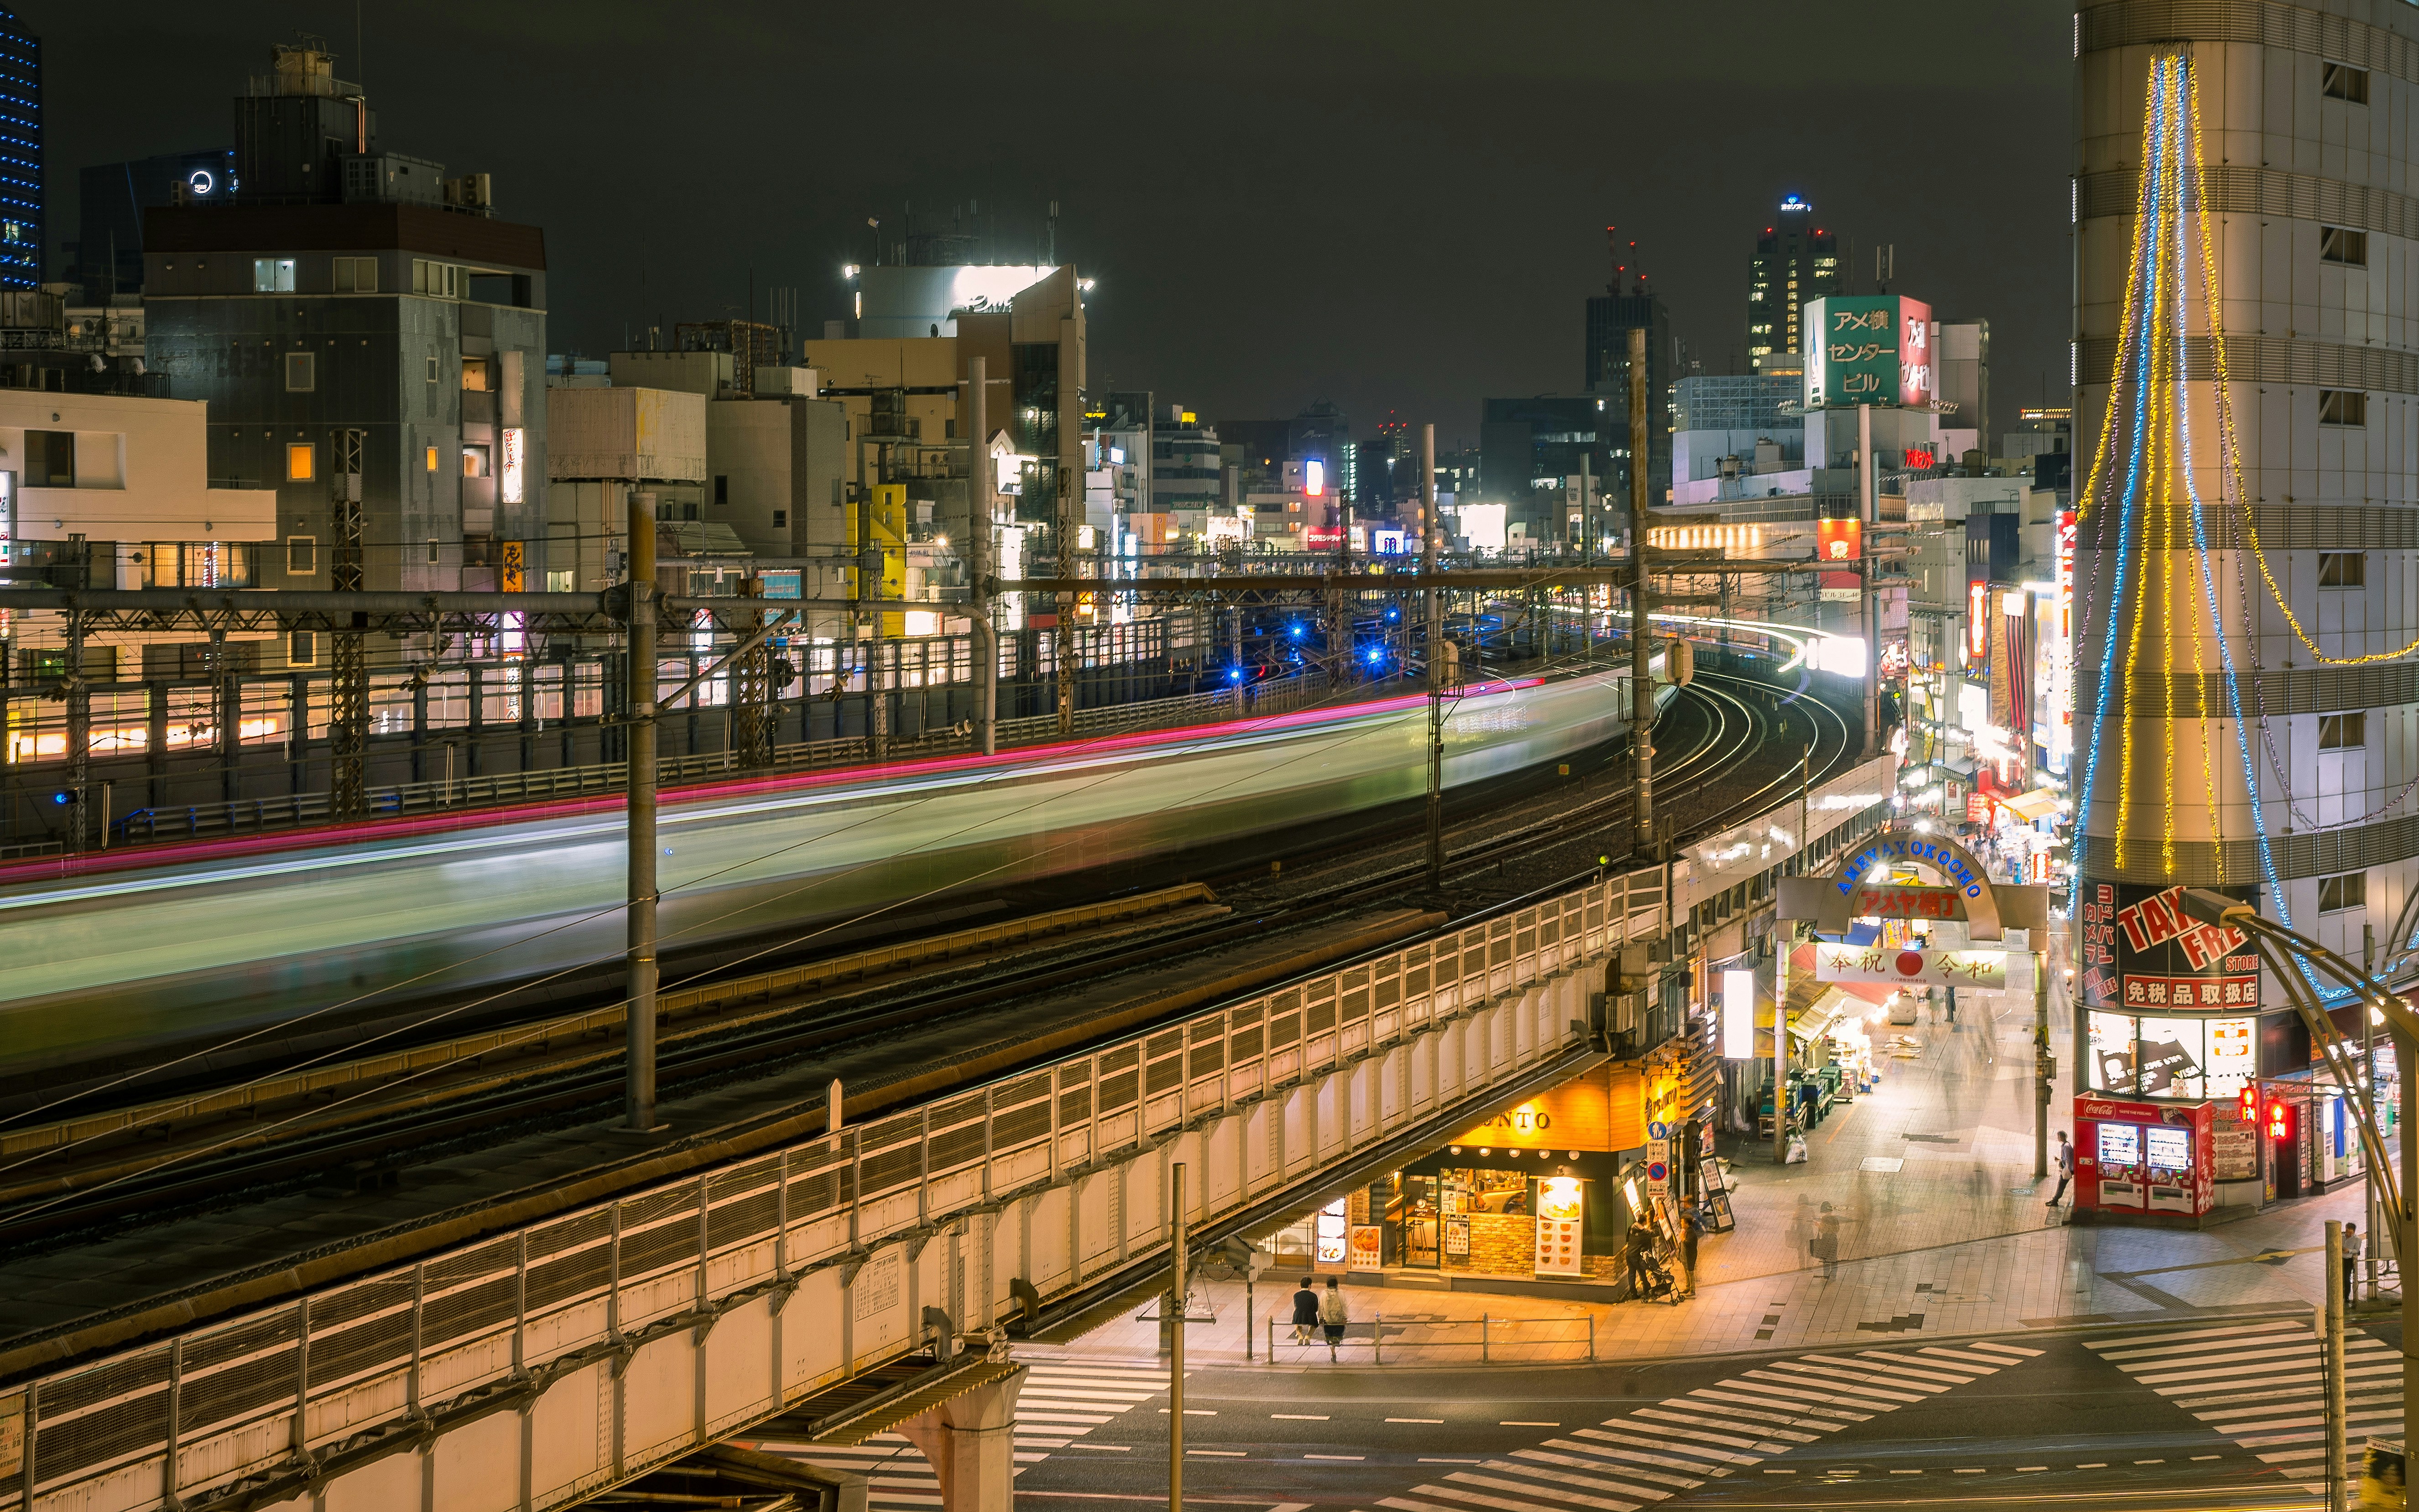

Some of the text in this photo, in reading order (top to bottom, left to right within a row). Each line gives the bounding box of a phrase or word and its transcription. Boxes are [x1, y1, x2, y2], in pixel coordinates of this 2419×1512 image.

[1834, 310, 1889, 332] アメ横
[1828, 344, 1896, 362] センター
[1844, 373, 1880, 392] ビル
[1837, 839, 1981, 899] AMEYAYOKOCHO
[1861, 890, 1962, 917] アメヤ横丁
[2097, 884, 2114, 965] ヨドバシ
[2118, 885, 2204, 954] TAX
[2084, 902, 2096, 963] カメラ
[1829, 950, 1992, 979] 奉祝 令和
[2225, 954, 2259, 972] STORE
[2082, 967, 2103, 991] TAX
[2093, 976, 2118, 1001] FREE
[2127, 980, 2256, 1005] 免税品取扱店
